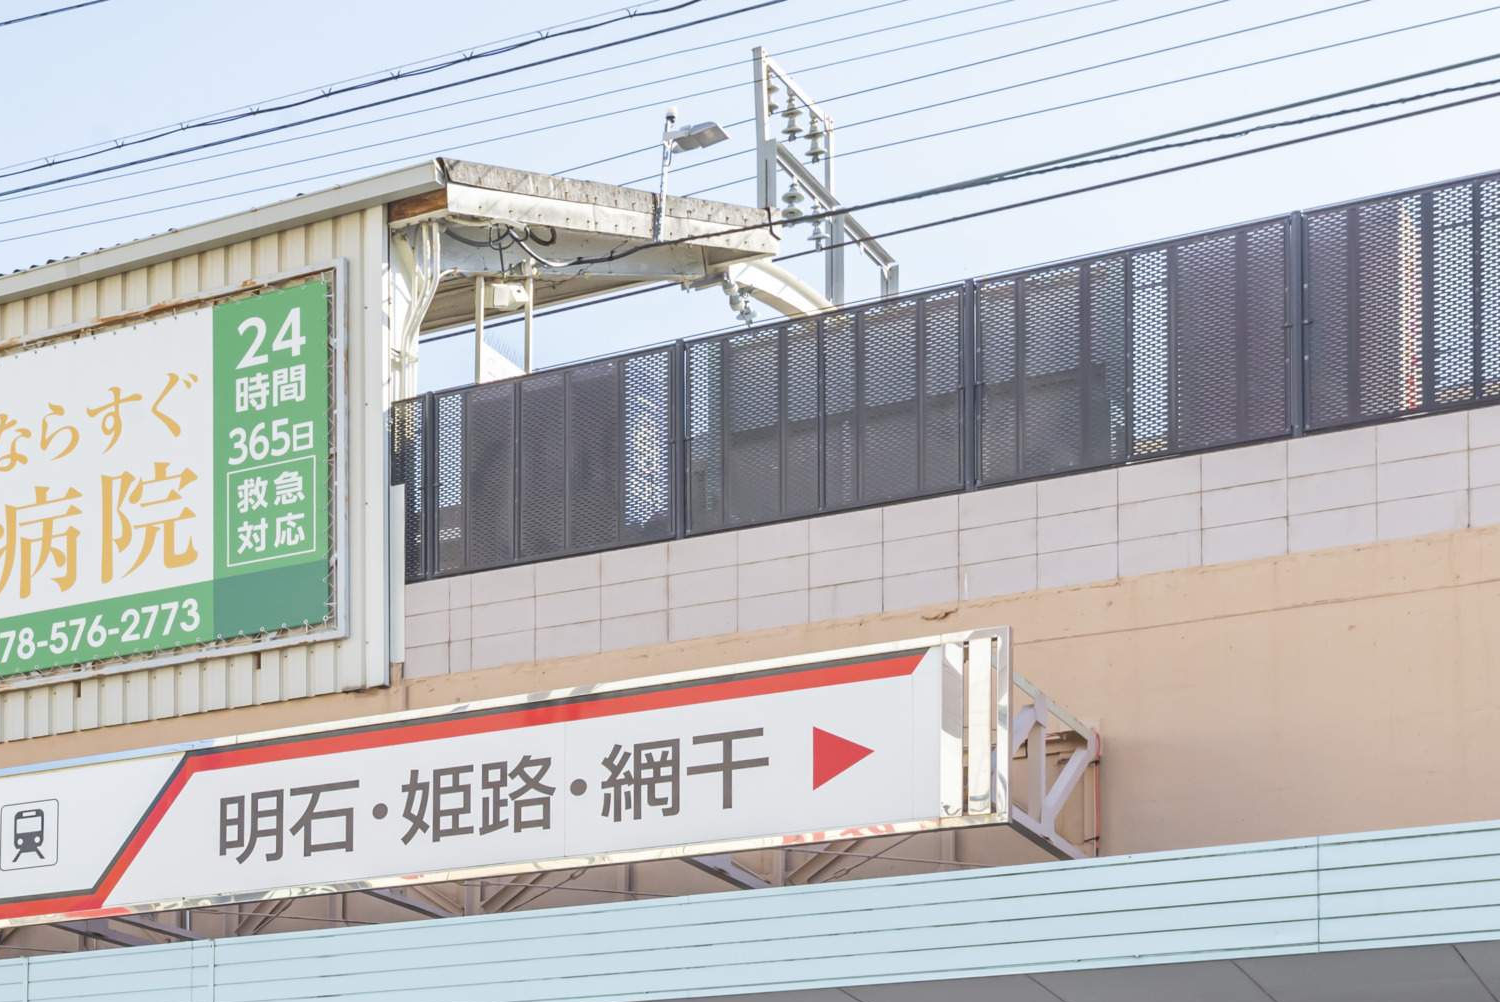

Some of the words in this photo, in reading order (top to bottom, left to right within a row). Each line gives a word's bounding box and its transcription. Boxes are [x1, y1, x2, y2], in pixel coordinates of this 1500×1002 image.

[235, 308, 306, 370] 24
[235, 365, 306, 412] 時間
[228, 418, 313, 466] 365日
[236, 474, 306, 513] 救急
[236, 513, 306, 554] 対応
[218, 727, 769, 865] 明石・姫路・網干
